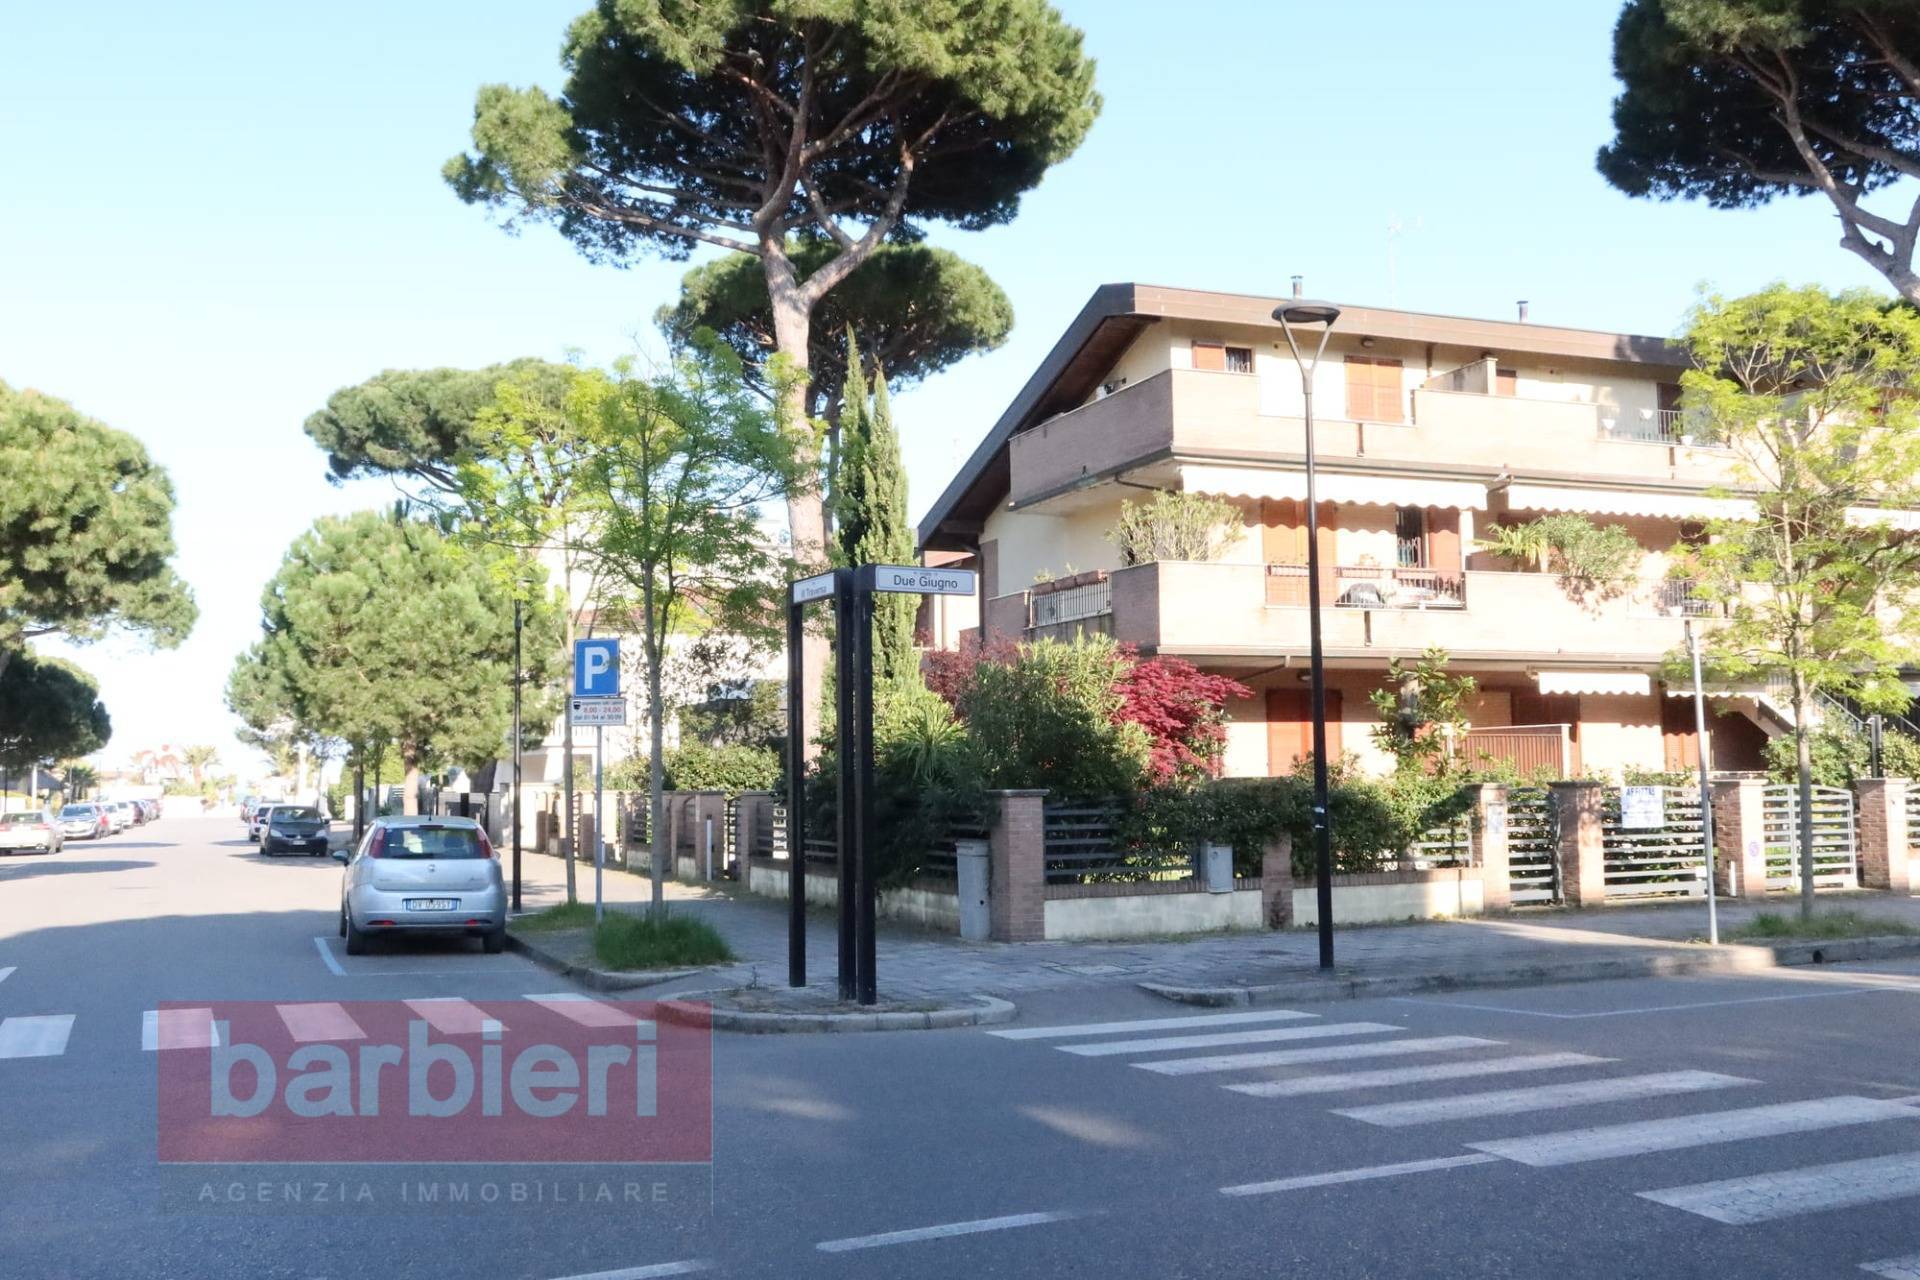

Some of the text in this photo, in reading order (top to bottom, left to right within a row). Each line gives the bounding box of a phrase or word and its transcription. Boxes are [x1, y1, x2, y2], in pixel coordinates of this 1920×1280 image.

[893, 574, 916, 586] Due
[919, 576, 958, 591] Giugno
[584, 646, 610, 690] P
